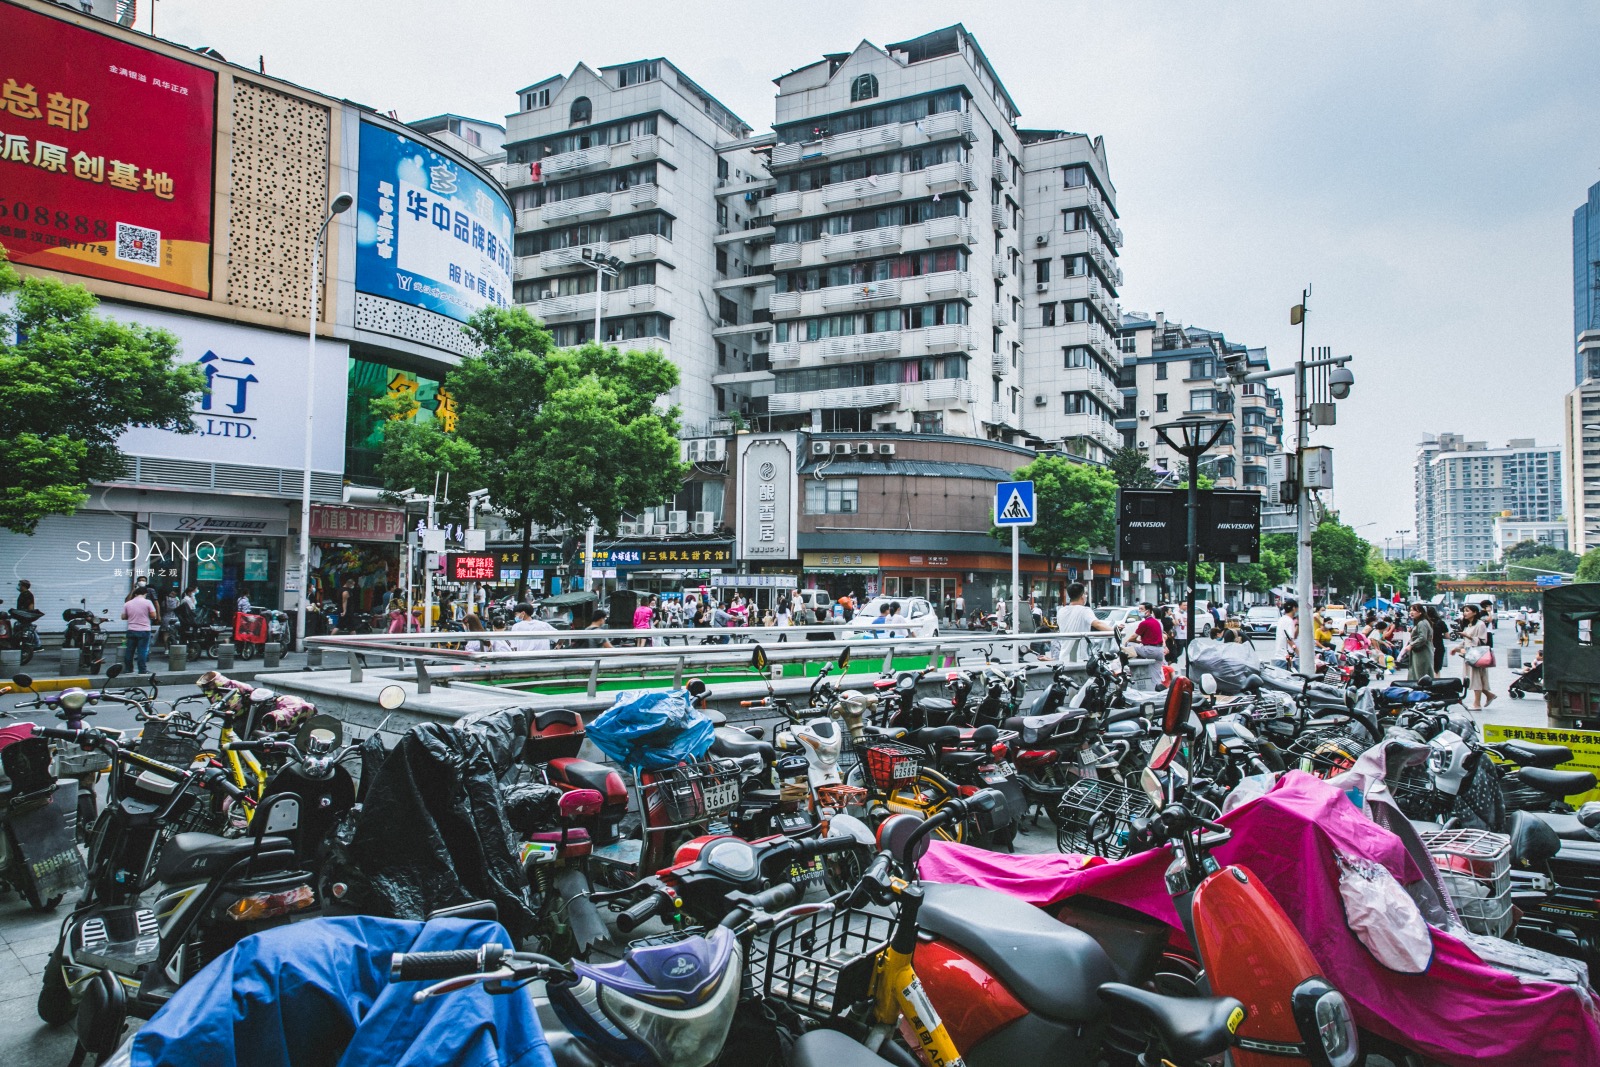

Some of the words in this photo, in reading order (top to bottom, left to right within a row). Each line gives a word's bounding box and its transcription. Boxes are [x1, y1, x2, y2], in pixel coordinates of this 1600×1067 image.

[152, 78, 189, 96] 风华正茂
[0, 78, 91, 132] 总部
[0, 130, 176, 200] 派原创基地
[406, 189, 514, 284] 华中品牌服饰
[199, 350, 259, 415] 行
[311, 509, 348, 530] 厂价直销
[349, 512, 375, 532] 工作服
[376, 514, 401, 534] 广告衫
[1128, 520, 1167, 529] HIKVISION
[1216, 522, 1256, 531] HIKVISION
[456, 556, 494, 568] 严管路段
[647, 550, 725, 561] 三镇民生甜食馆
[820, 555, 863, 565] 立立烟酒
[456, 567, 494, 579] 禁止停车
[706, 790, 738, 809] 36616
